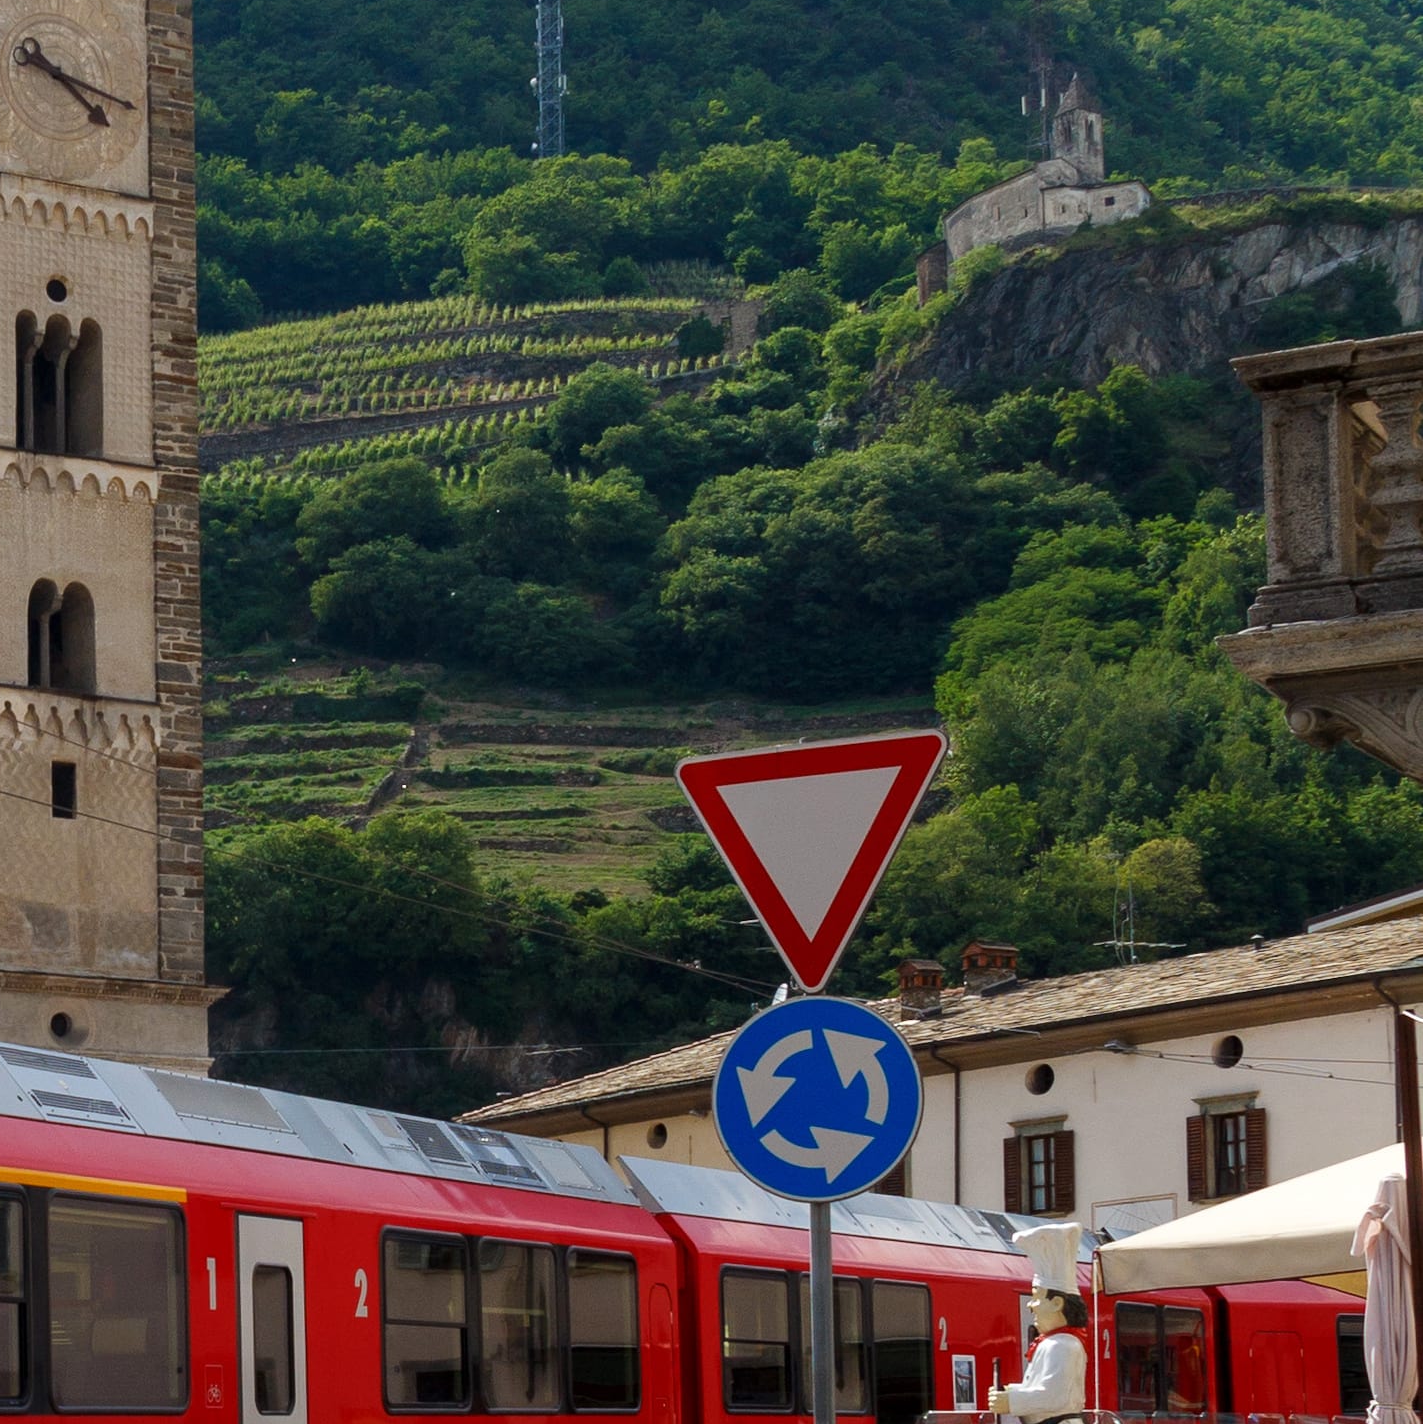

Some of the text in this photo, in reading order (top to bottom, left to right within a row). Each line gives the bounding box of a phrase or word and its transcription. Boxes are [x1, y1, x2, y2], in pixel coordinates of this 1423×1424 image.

[206, 1258, 217, 1310] 1
[354, 1269, 369, 1318] 2
[938, 1317, 949, 1351] 2
[1103, 1329, 1111, 1359] 2
